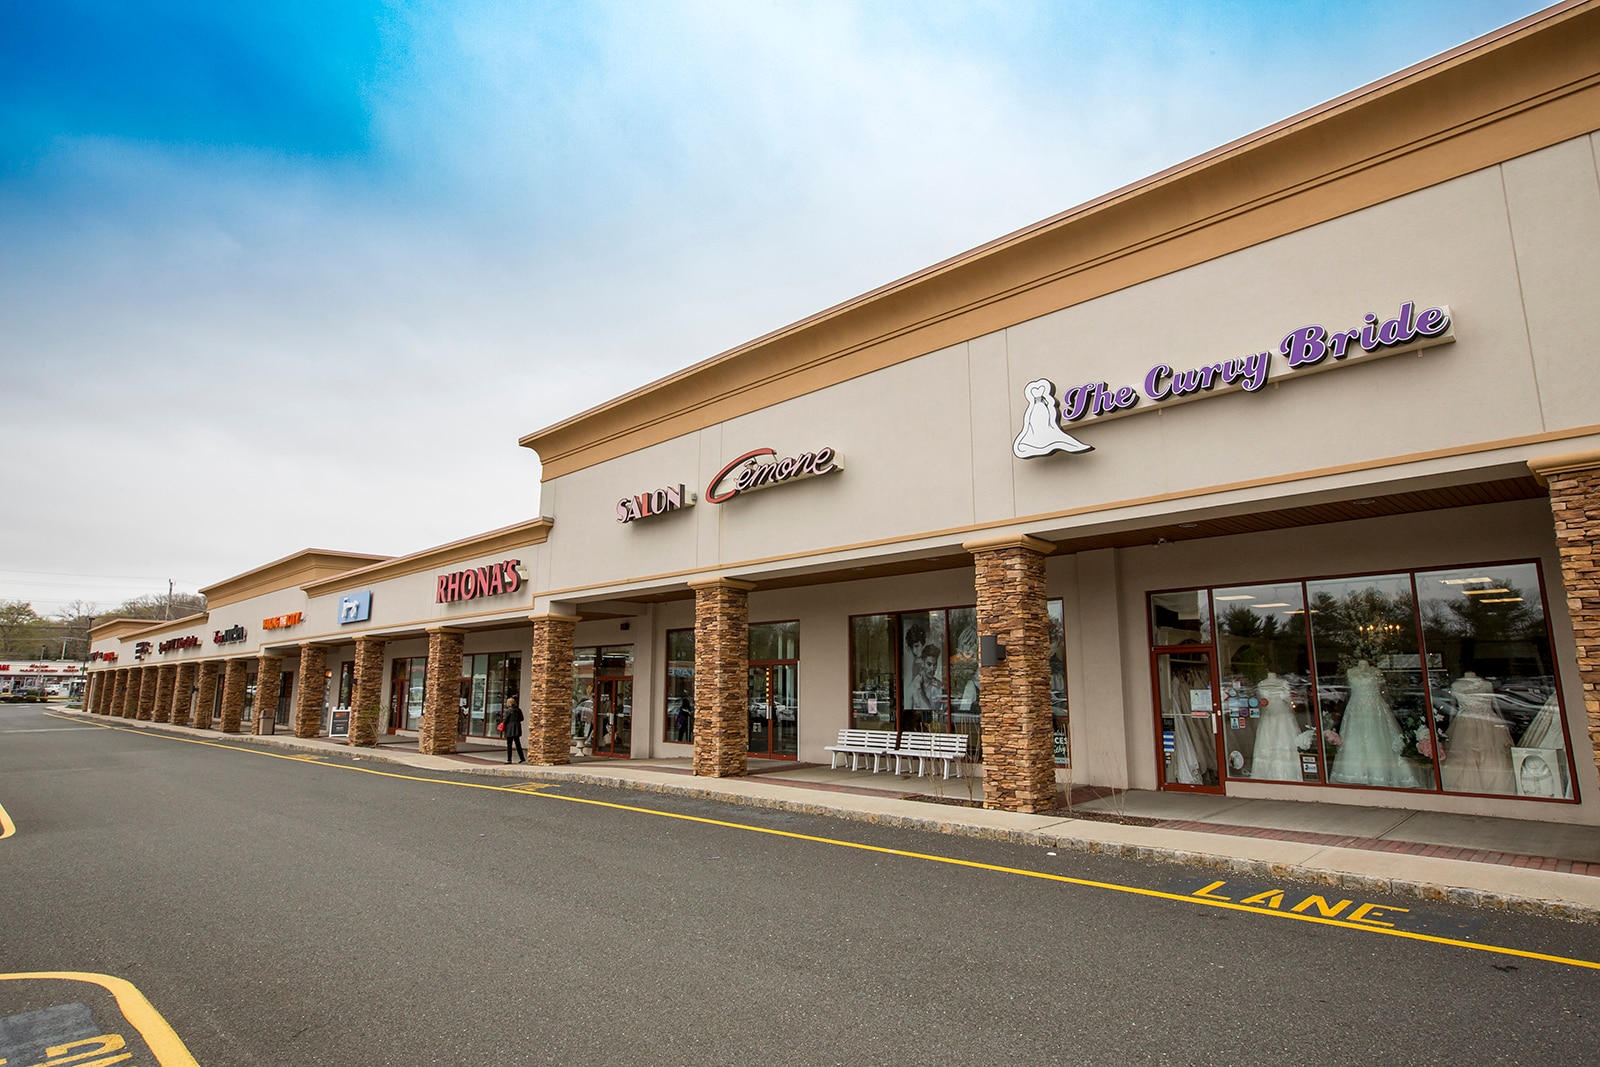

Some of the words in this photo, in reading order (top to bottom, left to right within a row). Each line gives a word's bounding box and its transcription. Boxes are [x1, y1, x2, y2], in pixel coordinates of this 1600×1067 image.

[1062, 381, 1139, 421] The
[1143, 363, 1272, 393] Curvy
[1279, 301, 1452, 368] Bride
[616, 483, 685, 524] SALON
[436, 559, 521, 603] RHONA'S
[1192, 880, 1410, 927] LANE
